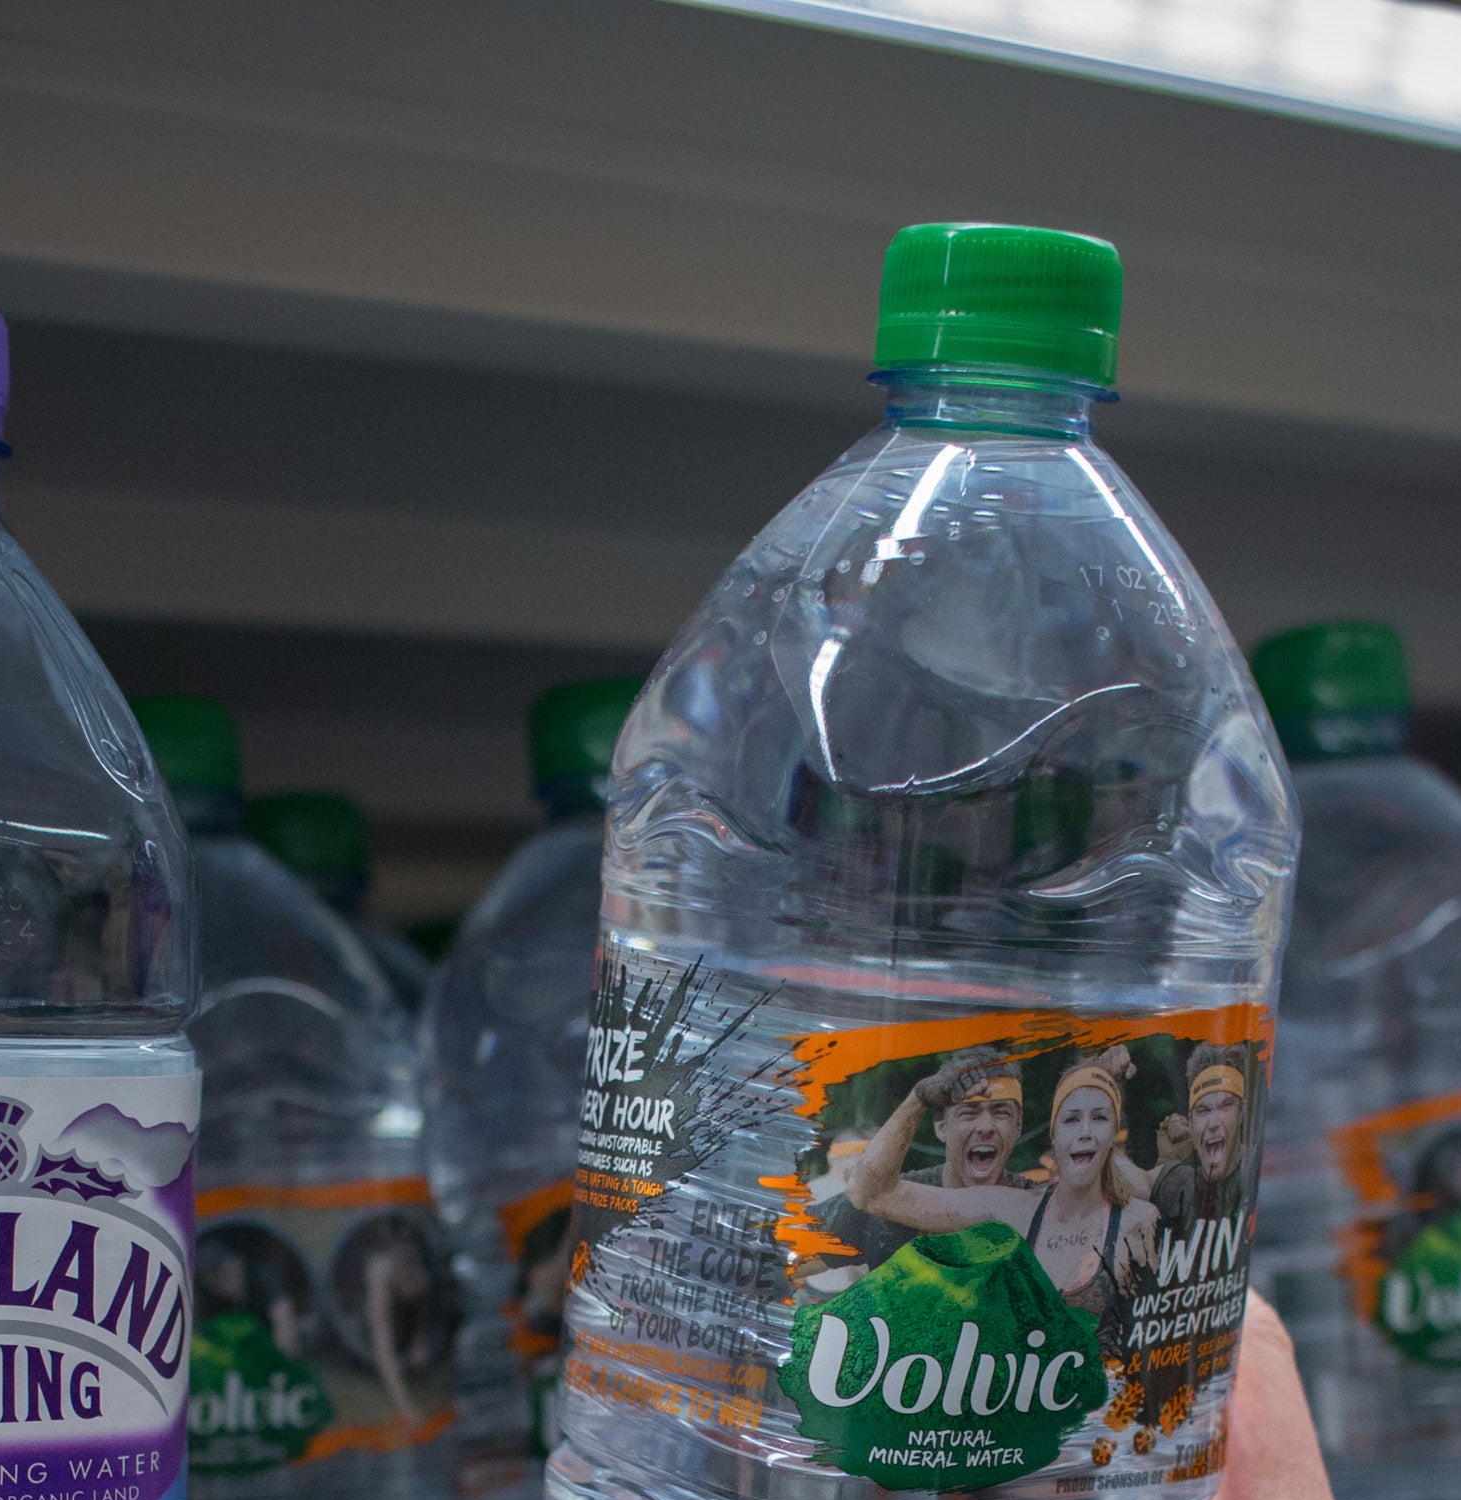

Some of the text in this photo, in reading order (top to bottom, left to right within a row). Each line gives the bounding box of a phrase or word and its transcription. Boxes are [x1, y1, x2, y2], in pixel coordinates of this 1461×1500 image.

[613, 1094, 675, 1141] HOUR
[598, 1132, 662, 1157] UNSTOPPABLE
[612, 1156, 638, 1175] SUCH
[637, 1160, 654, 1178] AS
[621, 1178, 631, 1195] &
[632, 1177, 664, 1198] TOUGH
[610, 1195, 639, 1214] PACKS
[691, 1198, 780, 1246] ENTER
[648, 1236, 779, 1289] THE CODE
[1157, 1208, 1247, 1288] WIN
[620, 1273, 774, 1325] FROM THE NECK
[1131, 1266, 1247, 1319] UNSTOPPABLE
[610, 1307, 632, 1337] OF
[636, 1311, 682, 1350] YOUR
[1126, 1293, 1245, 1351] ADVENTURES
[808, 1314, 1086, 1417] Volvic
[1126, 1341, 1192, 1375] & MORE
[1197, 1339, 1215, 1360] SEE
[188, 1370, 318, 1434] olvic
[595, 1366, 608, 1399] A
[612, 1371, 682, 1416] CHANCE
[686, 1386, 714, 1423] TO
[718, 1392, 765, 1431] WIN
[867, 1446, 1026, 1468] MINERAL WATER
[907, 1429, 997, 1448] NATURAL
[67, 1450, 161, 1481] WATER
[1055, 1476, 1096, 1494] PROUD
[1096, 1471, 1149, 1491] SPONSOR
